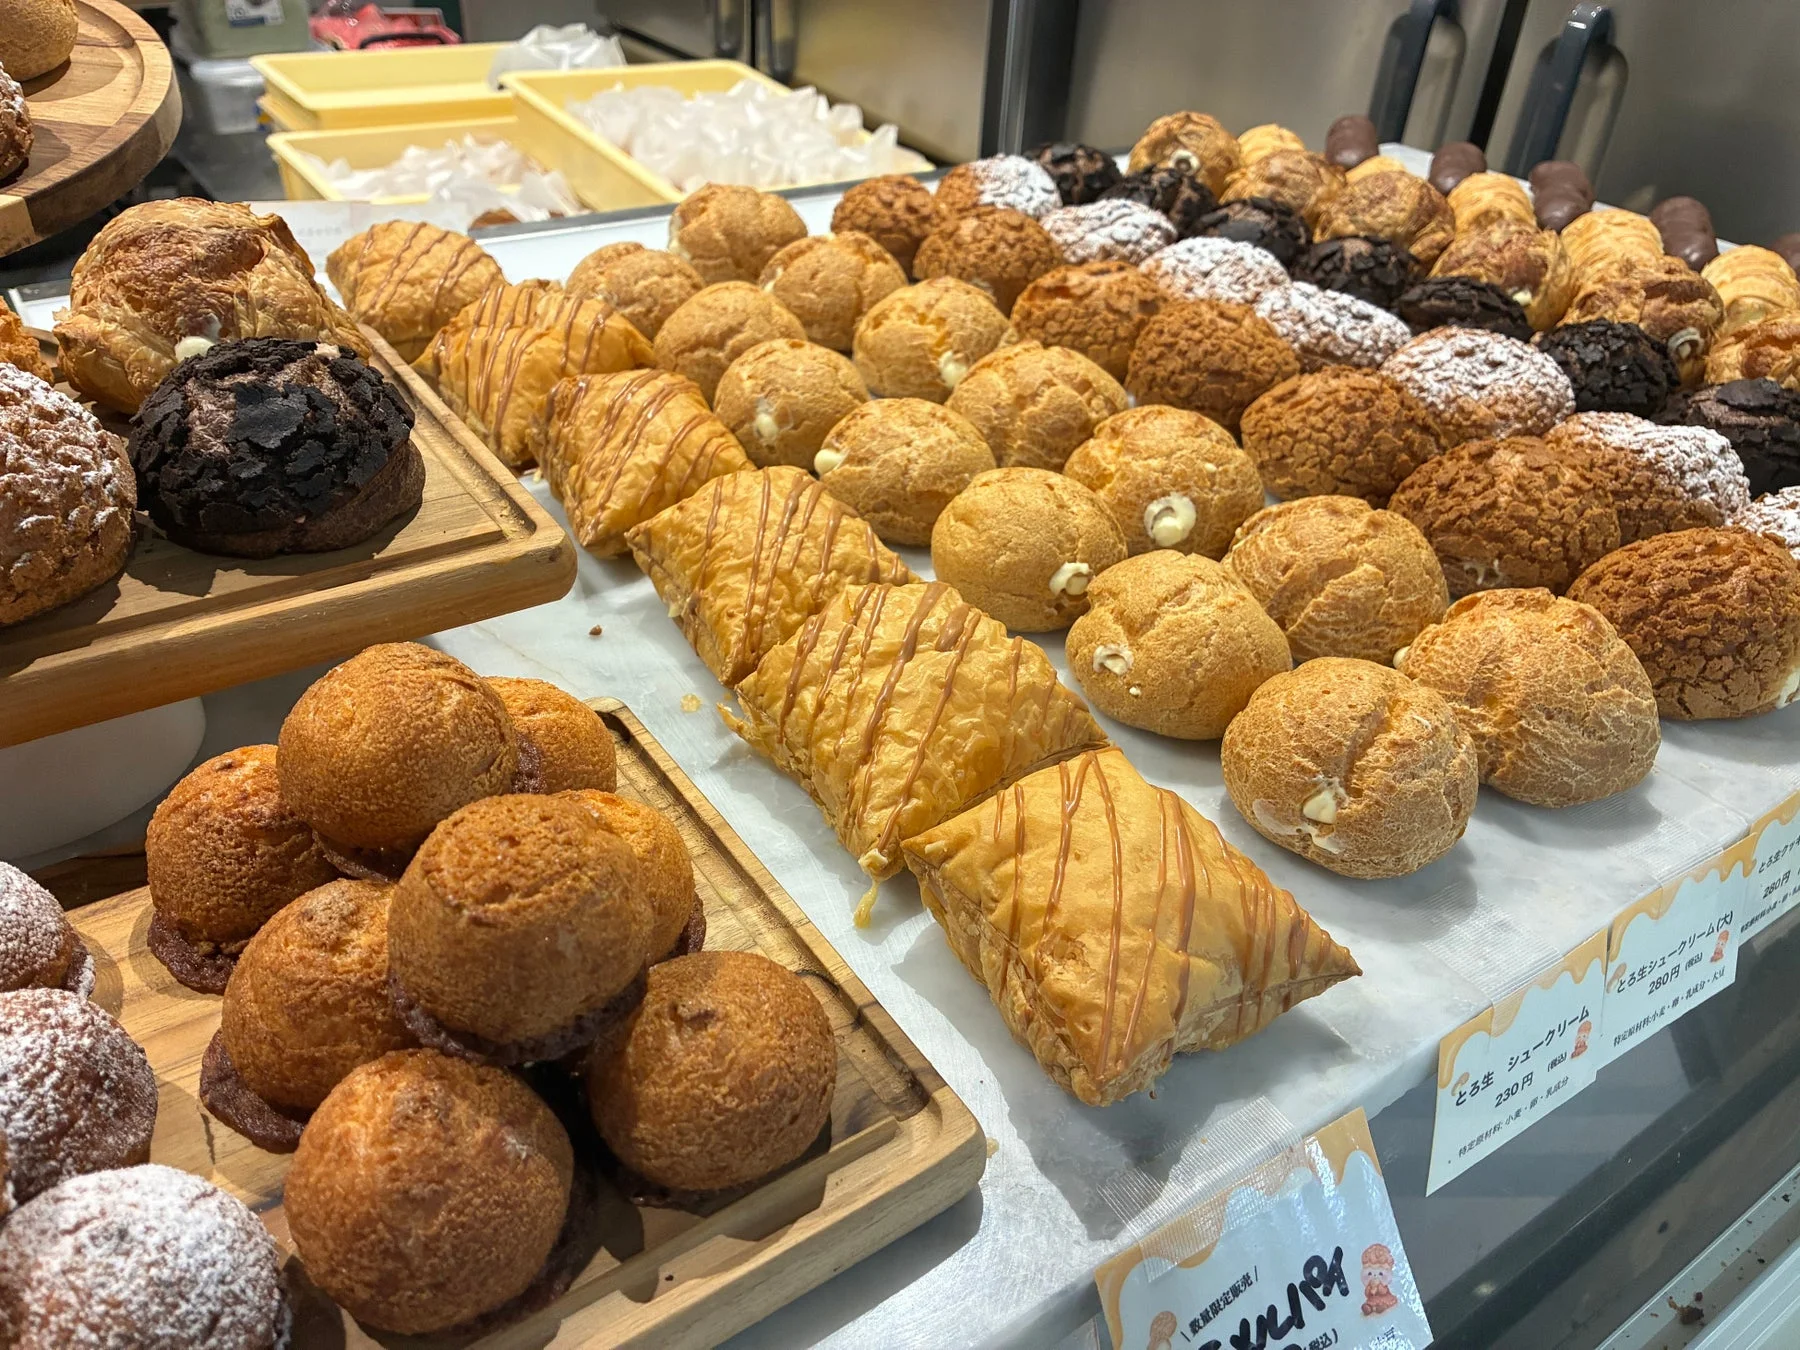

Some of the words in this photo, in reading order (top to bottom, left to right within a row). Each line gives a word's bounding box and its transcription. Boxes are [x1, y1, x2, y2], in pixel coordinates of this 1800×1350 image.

[1647, 963, 1681, 995] 280円
[1455, 1071, 1494, 1107] とろ生
[1507, 1005, 1590, 1073] シュークリーム
